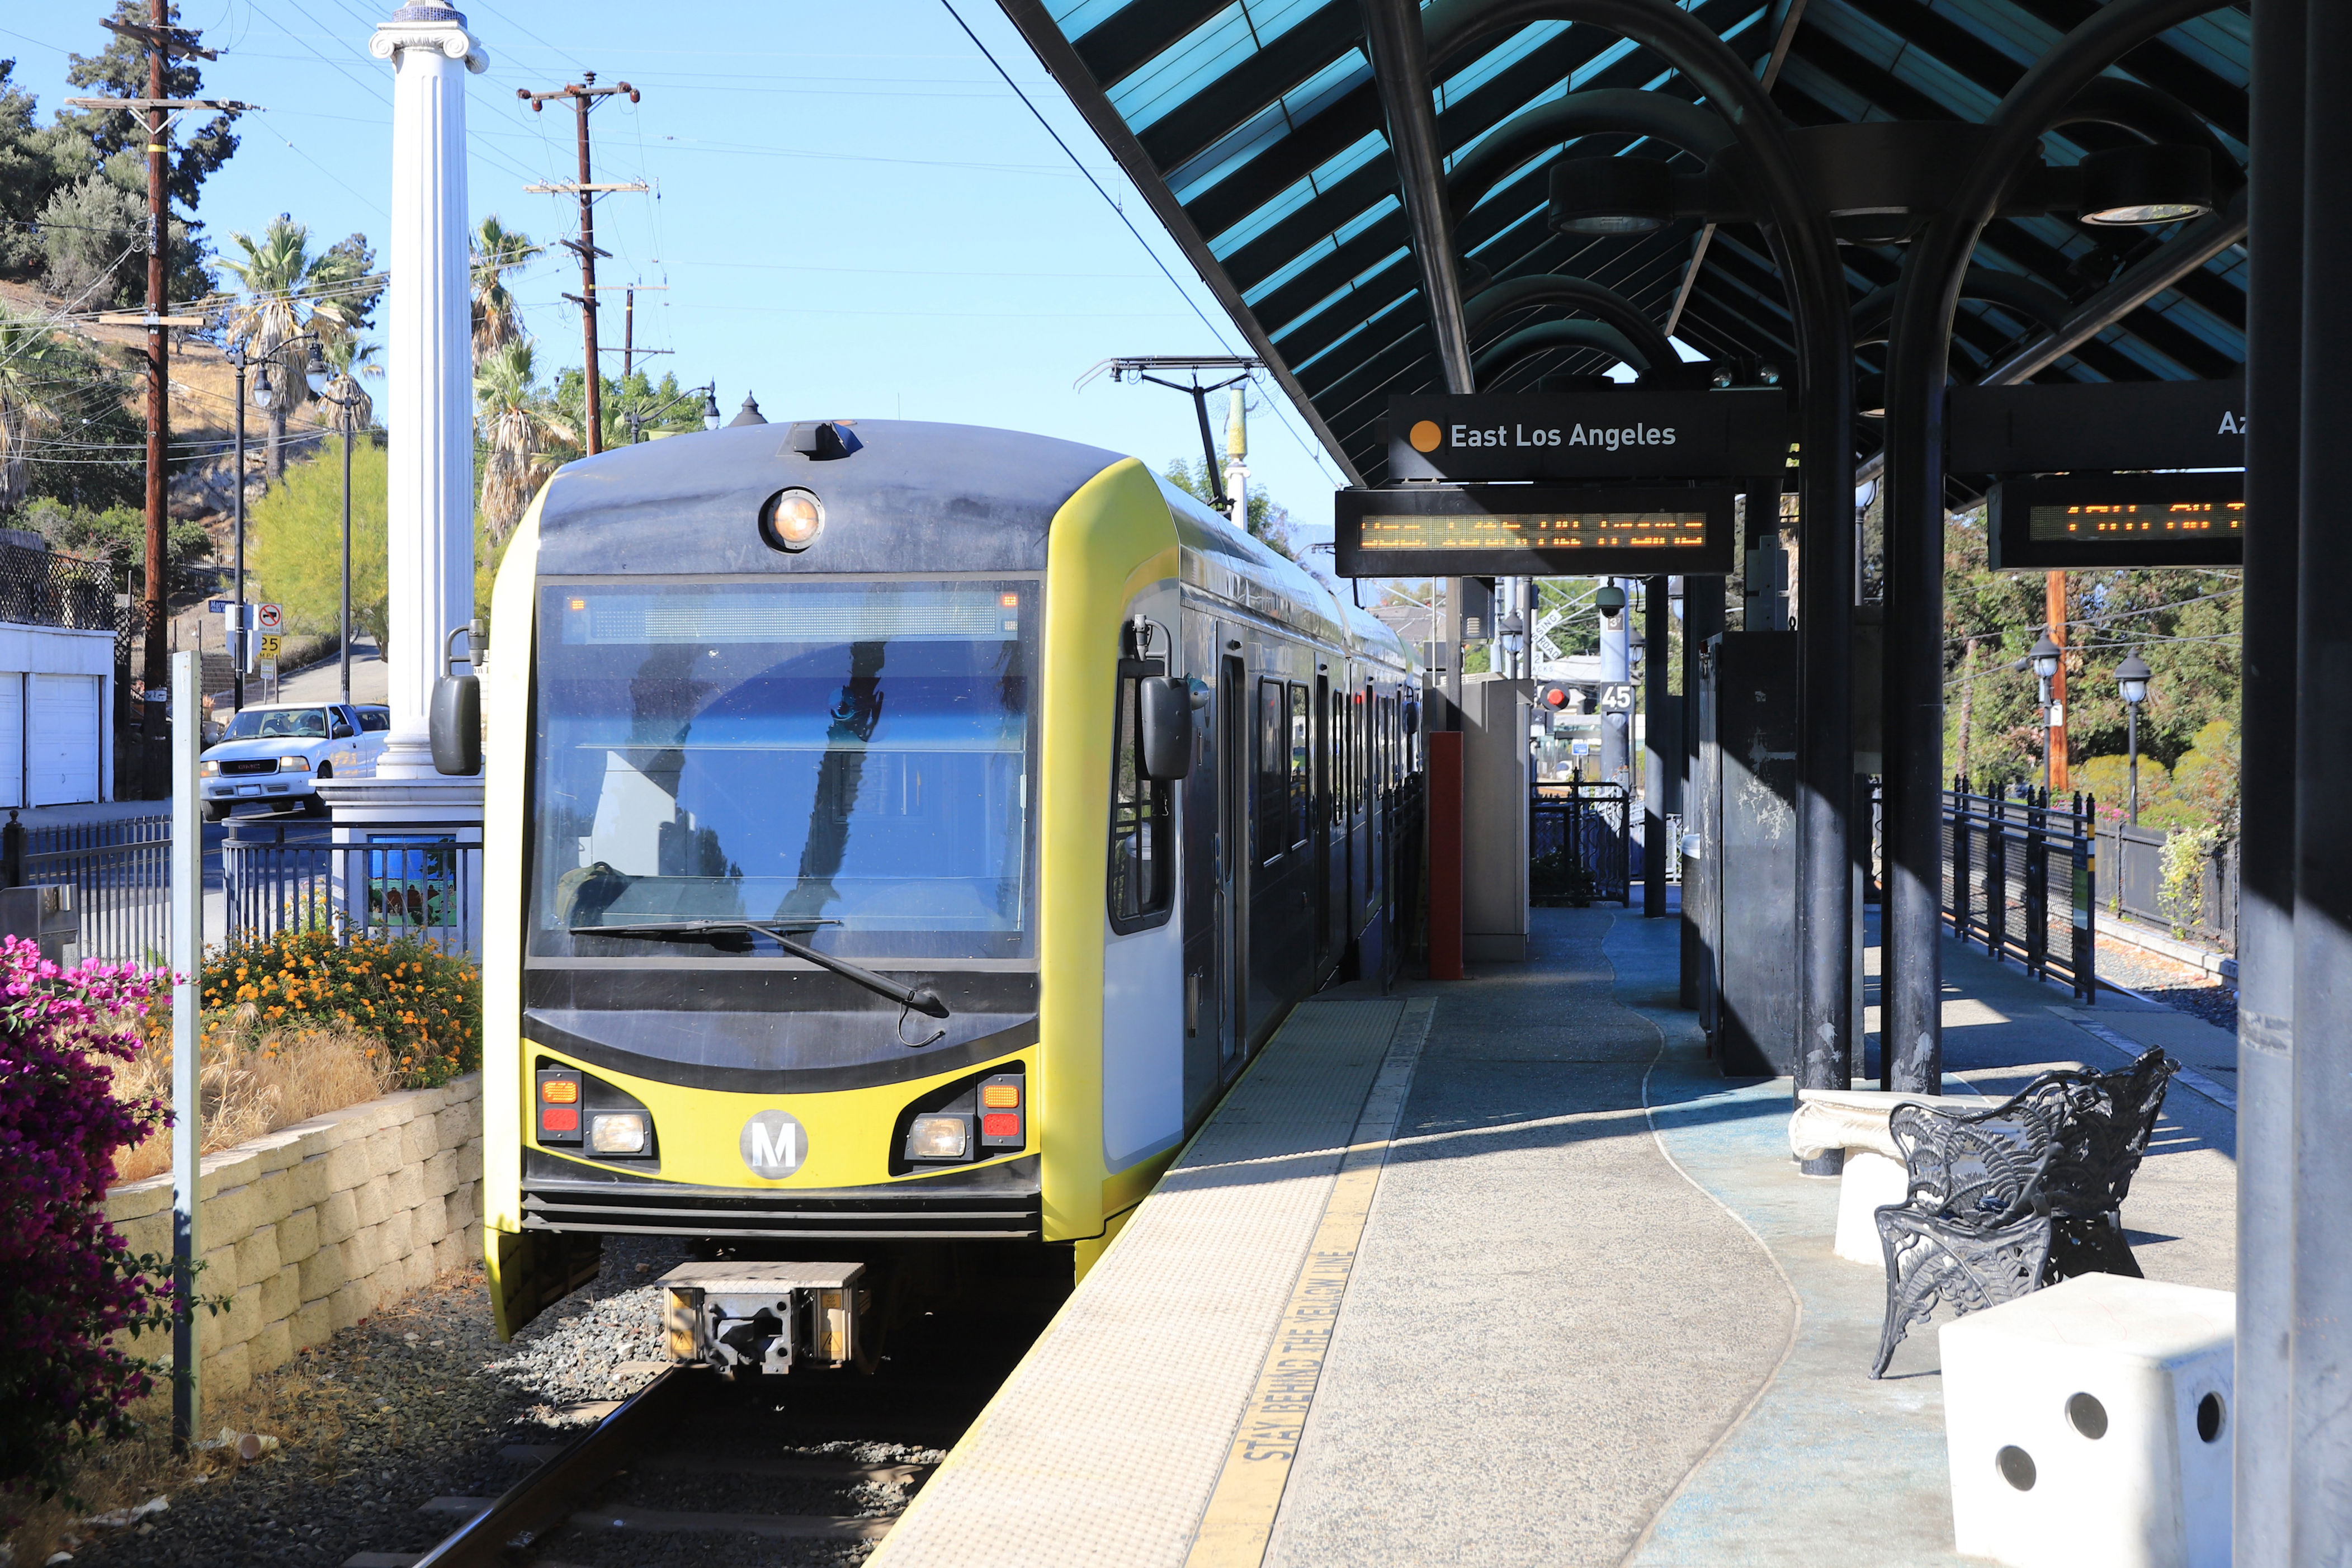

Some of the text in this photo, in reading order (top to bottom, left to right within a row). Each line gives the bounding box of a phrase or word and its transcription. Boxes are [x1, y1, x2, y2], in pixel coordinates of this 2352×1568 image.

[1451, 422, 1676, 451] East Los Angeles
[1532, 615, 1557, 640] SSING
[262, 637, 277, 651] 25
[1534, 655, 1541, 664] 2
[1602, 686, 1631, 708] 45
[752, 1122, 796, 1167] M
[1243, 1251, 1354, 1461] STAY BEHIND THE YELLOW LINE
